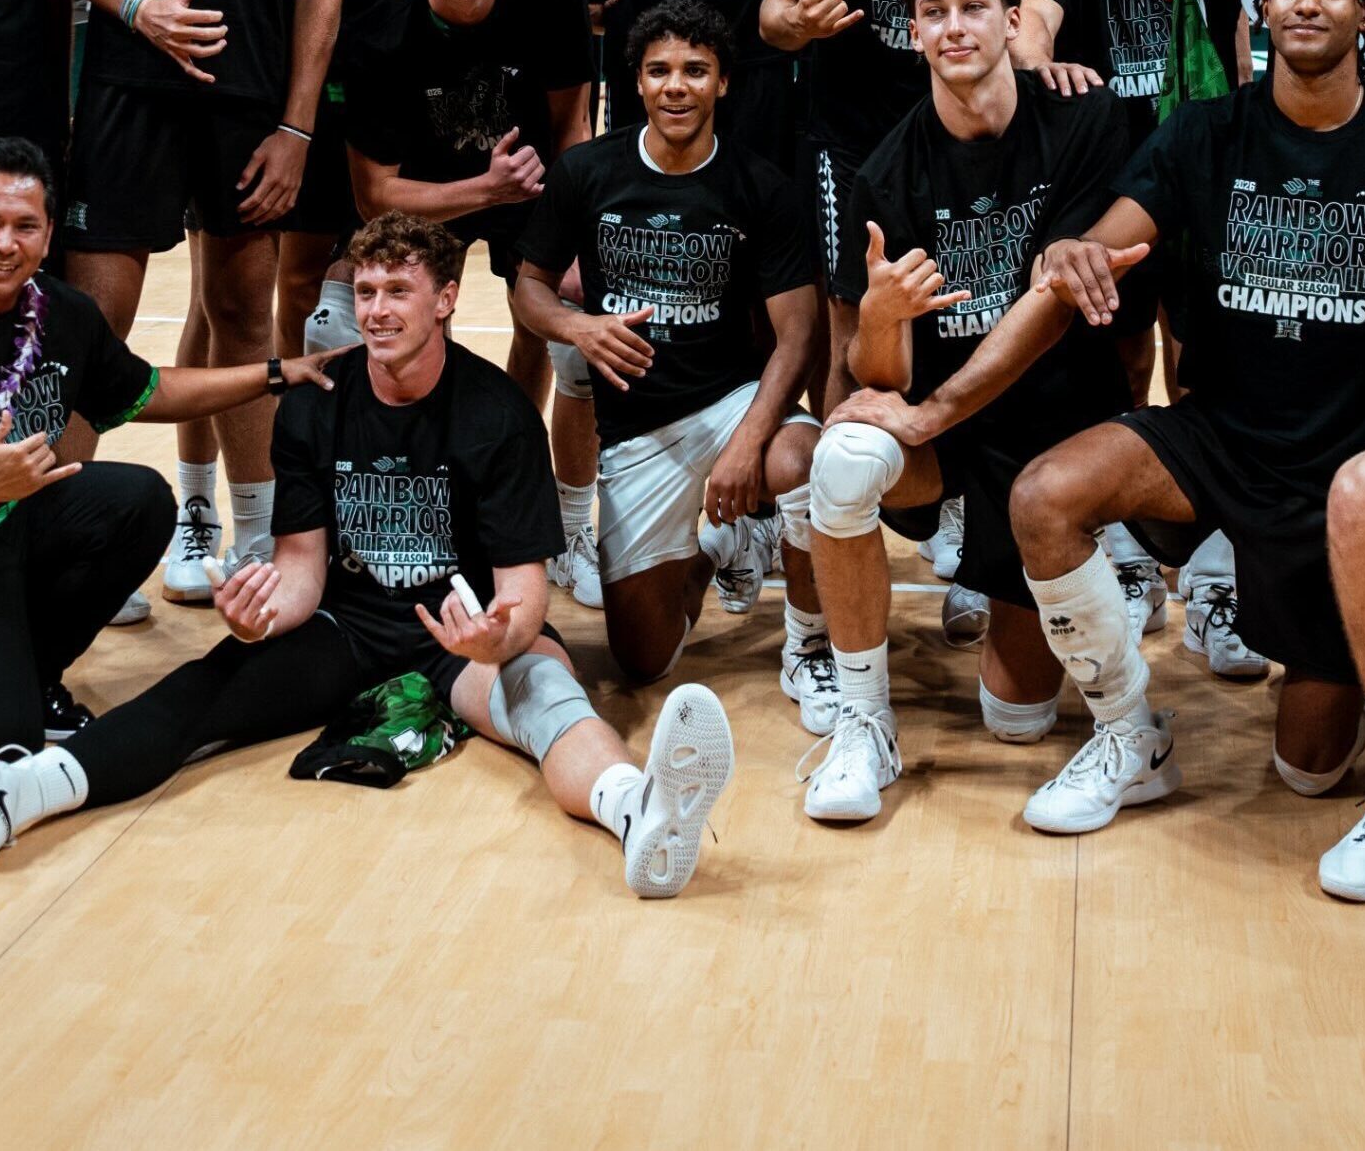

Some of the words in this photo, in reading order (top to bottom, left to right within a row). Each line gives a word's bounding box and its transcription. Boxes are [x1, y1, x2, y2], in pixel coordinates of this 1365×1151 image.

[1120, 63, 1158, 73] REGULAR
[1234, 179, 1255, 192] 2026
[601, 212, 621, 224] 2026
[598, 223, 732, 261] RAINBOW
[598, 249, 730, 284] WARRIOR
[1248, 276, 1294, 291] REGULAR
[1297, 282, 1337, 295] SEASON
[627, 290, 662, 302] REGULAR
[665, 294, 699, 303] SEASON
[960, 295, 1002, 312] REGULAR
[334, 473, 450, 507] RAINBOW
[393, 553, 429, 563] SEASON
